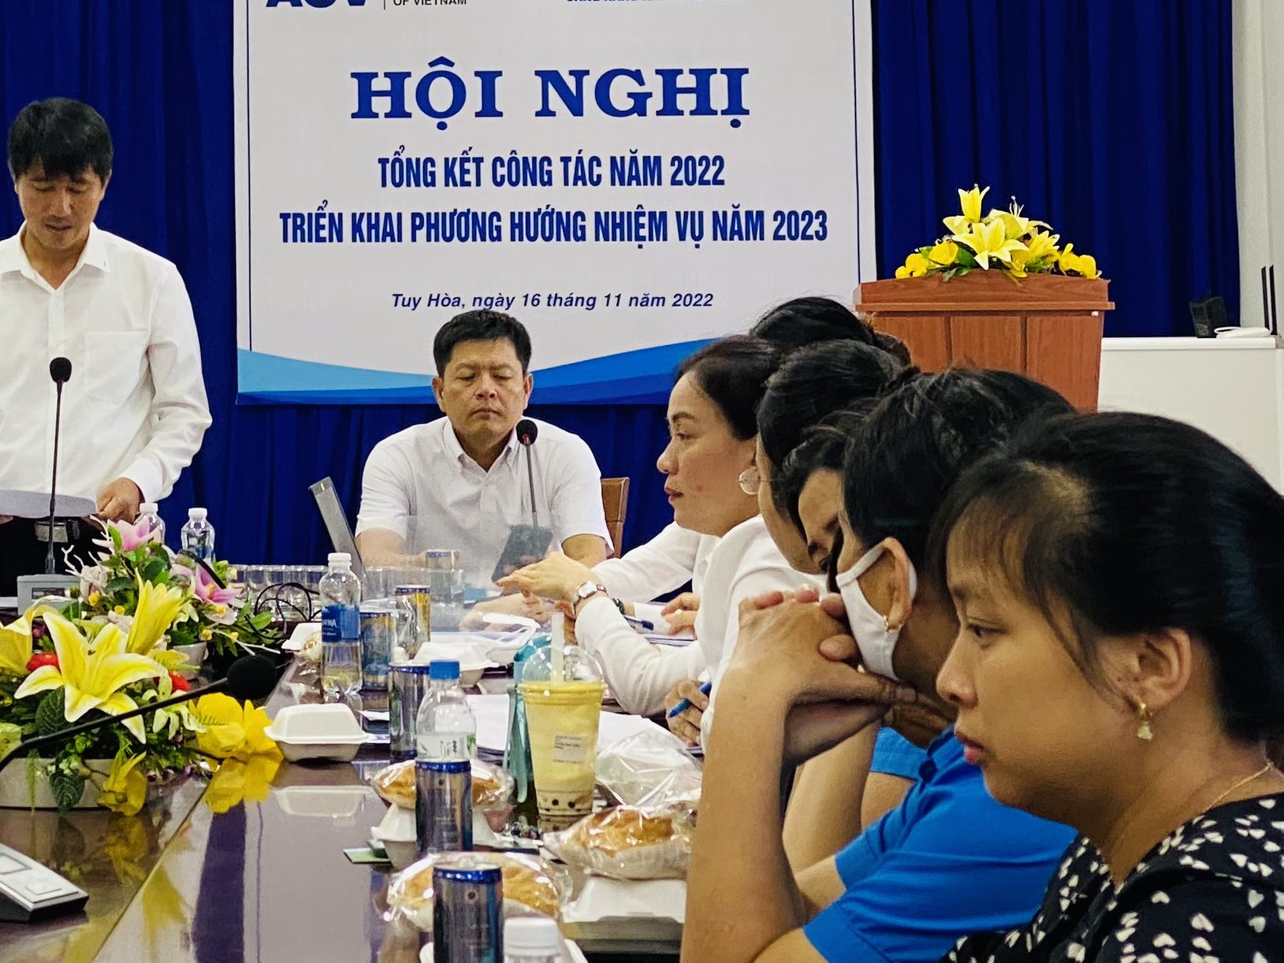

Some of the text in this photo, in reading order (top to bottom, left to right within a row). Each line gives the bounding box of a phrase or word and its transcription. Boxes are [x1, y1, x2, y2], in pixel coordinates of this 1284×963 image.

[350, 55, 750, 131] HỘI NGHỊ
[377, 144, 726, 188] TỔNG KẾT CÔNG TÁC NĂM 2022
[279, 199, 829, 249] TRIỂN KHAI PHƯƠNG HƯỚNG NHIỆM VỤ NĂM 2023
[391, 292, 714, 311] Tuy Hòa, ngày 16 tháng 11 năm 2022
